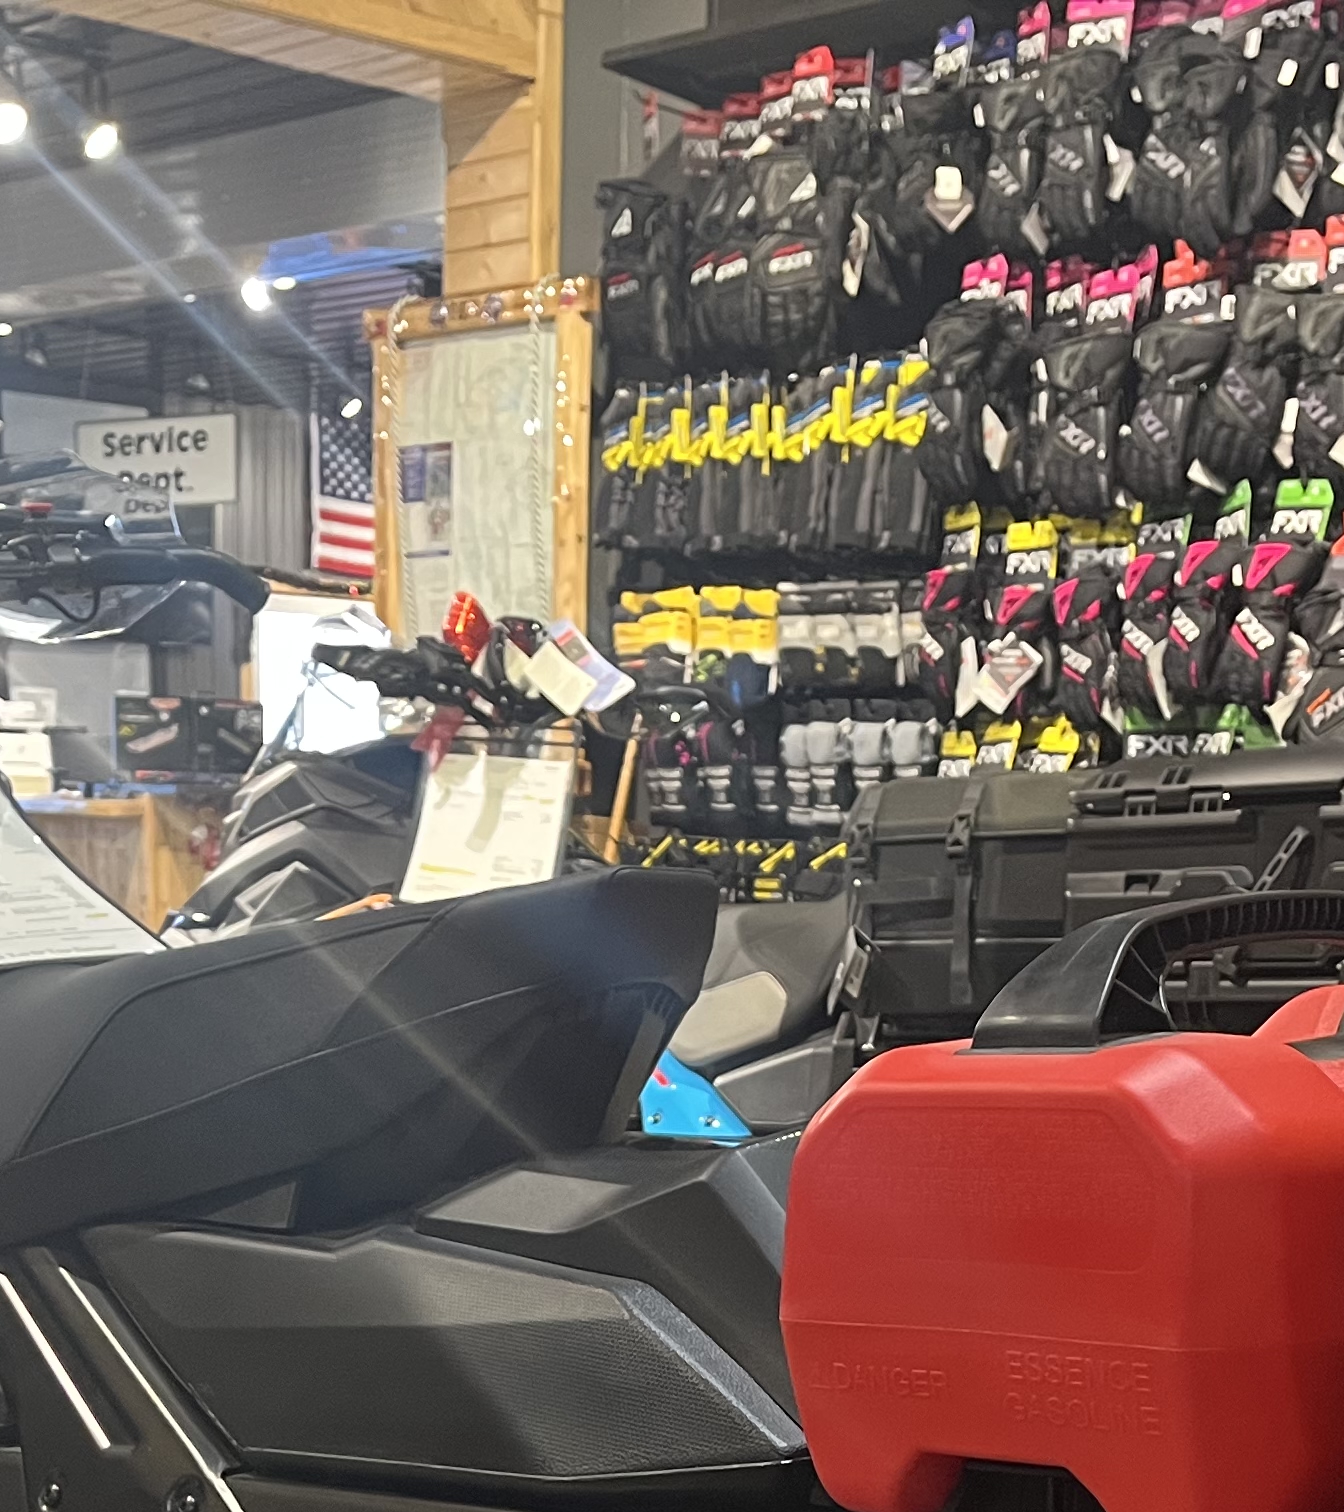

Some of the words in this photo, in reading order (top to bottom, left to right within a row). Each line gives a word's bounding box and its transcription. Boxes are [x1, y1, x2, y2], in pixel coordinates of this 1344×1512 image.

[1068, 16, 1127, 48] FXR
[1254, 261, 1318, 287] FXR
[1086, 294, 1132, 325] FXR
[1164, 281, 1222, 314] FXR
[103, 426, 209, 457] Service
[1270, 509, 1323, 534] FXR
[1005, 550, 1051, 575] FXR
[1127, 734, 1188, 758] FXR
[832, 1361, 949, 1398] DANGER
[1004, 1349, 1153, 1393] ESSENCE
[1003, 1390, 1164, 1436] GASOLINE
